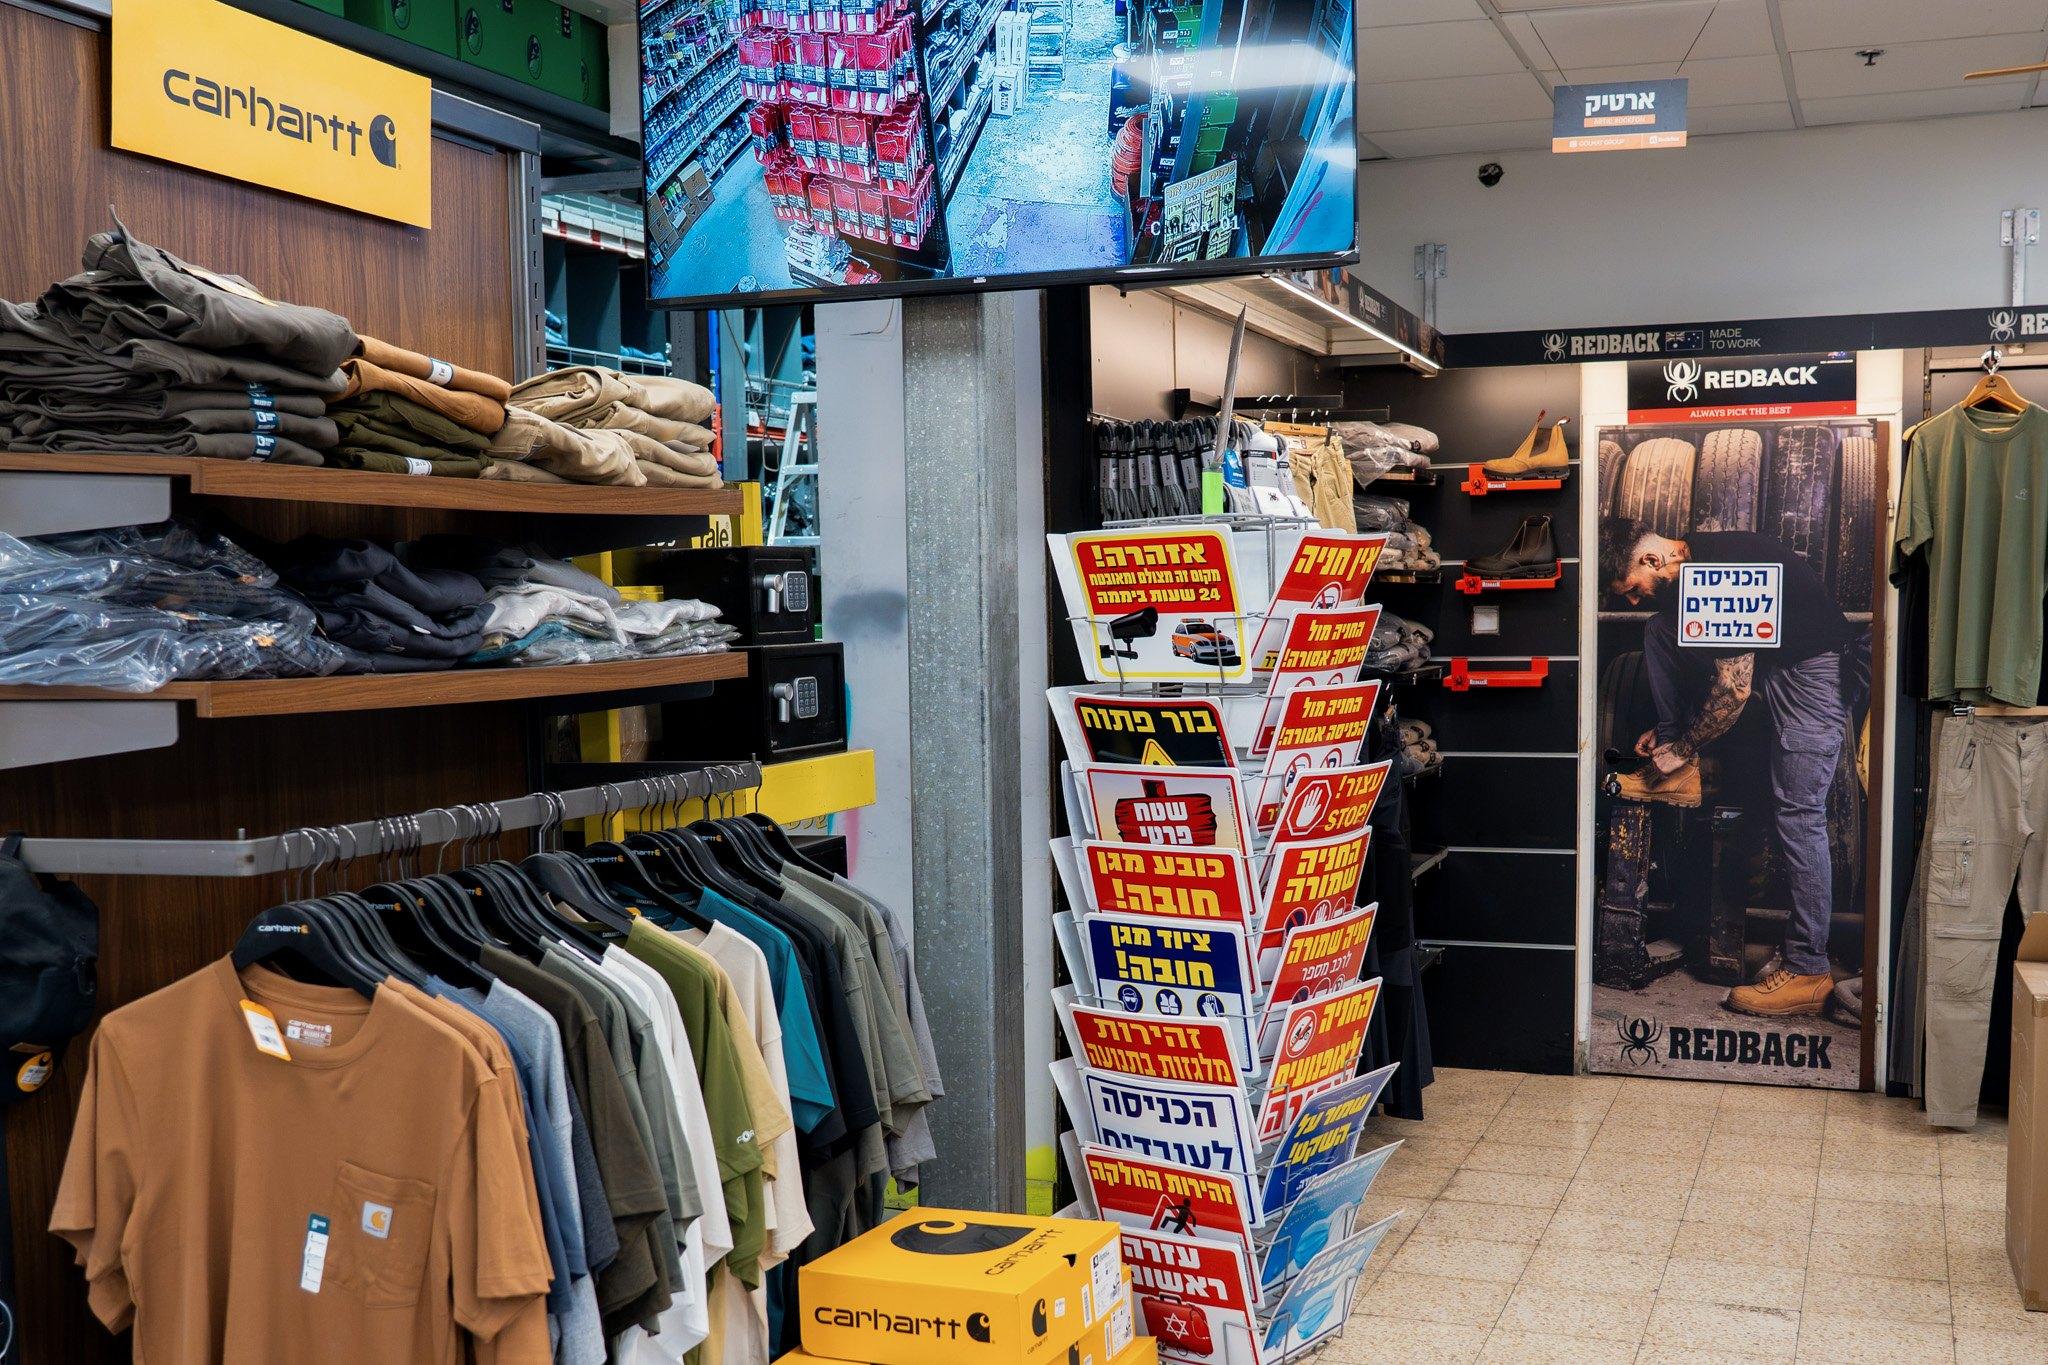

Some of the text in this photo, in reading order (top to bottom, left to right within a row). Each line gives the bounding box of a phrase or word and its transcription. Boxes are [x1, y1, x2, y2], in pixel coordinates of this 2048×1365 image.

[163, 69, 362, 156] carhartt
[1585, 92, 1655, 116] ארטיק
[1570, 333, 1660, 356] REDBACK
[1710, 328, 1742, 338] MADE
[1710, 338, 1761, 349] TO WORK
[1704, 365, 1818, 389] REDBACK
[1690, 406, 1792, 418] ALWAYS PICK THE BEST
[1091, 543, 1207, 568] אזהרה!
[1294, 545, 1381, 581] אין חניה
[1088, 568, 1221, 586] מקום זה מצולם ומאובטח
[1693, 570, 1767, 586] הכניסה
[1096, 587, 1221, 604] 24 שעות ביממה
[1686, 593, 1773, 613] לעובדים
[1307, 619, 1366, 641] החניה מול
[1705, 620, 1753, 637] בלבד!
[1281, 648, 1331, 668] אסורה!
[1330, 645, 1367, 666] הכניסה
[1079, 706, 1217, 733] בור פתוח
[1302, 696, 1363, 719] החניה מול
[1278, 720, 1367, 746] הכניסה אסורה!
[1335, 771, 1384, 799] עצור!
[1133, 801, 1189, 822] שטח
[1324, 799, 1373, 832] STOP!
[1139, 825, 1194, 845] פרטי
[1097, 851, 1226, 879] כובע מגן
[1296, 838, 1362, 875] החניה
[1283, 863, 1359, 903] שמורה
[1111, 878, 1221, 917] חובה!
[257, 923, 301, 933] carhartt
[1110, 925, 1212, 952] ציוד מגן
[1286, 916, 1373, 965] חניה שמורה
[1115, 950, 1215, 988] חובה!
[1302, 950, 1353, 981] לרכב מספר
[1318, 988, 1375, 1034] החניה
[1093, 1018, 1202, 1050] זהירות
[1668, 1026, 1832, 1069] REDBACK
[1086, 1042, 1232, 1083] מלגזות בתנועה
[1271, 1029, 1361, 1094] לאופנועים
[1100, 1086, 1217, 1128] הכניסה
[1323, 1092, 1373, 1126] שמור
[1293, 1111, 1324, 1138] על
[1285, 1122, 1352, 1167] השקט!
[1089, 1160, 1233, 1205] זהירות החלקה
[985, 1229, 1063, 1275] carhartt
[1121, 1236, 1201, 1270] עזרה
[1131, 1264, 1229, 1301] ראשונ
[815, 1306, 961, 1340] carhartt
